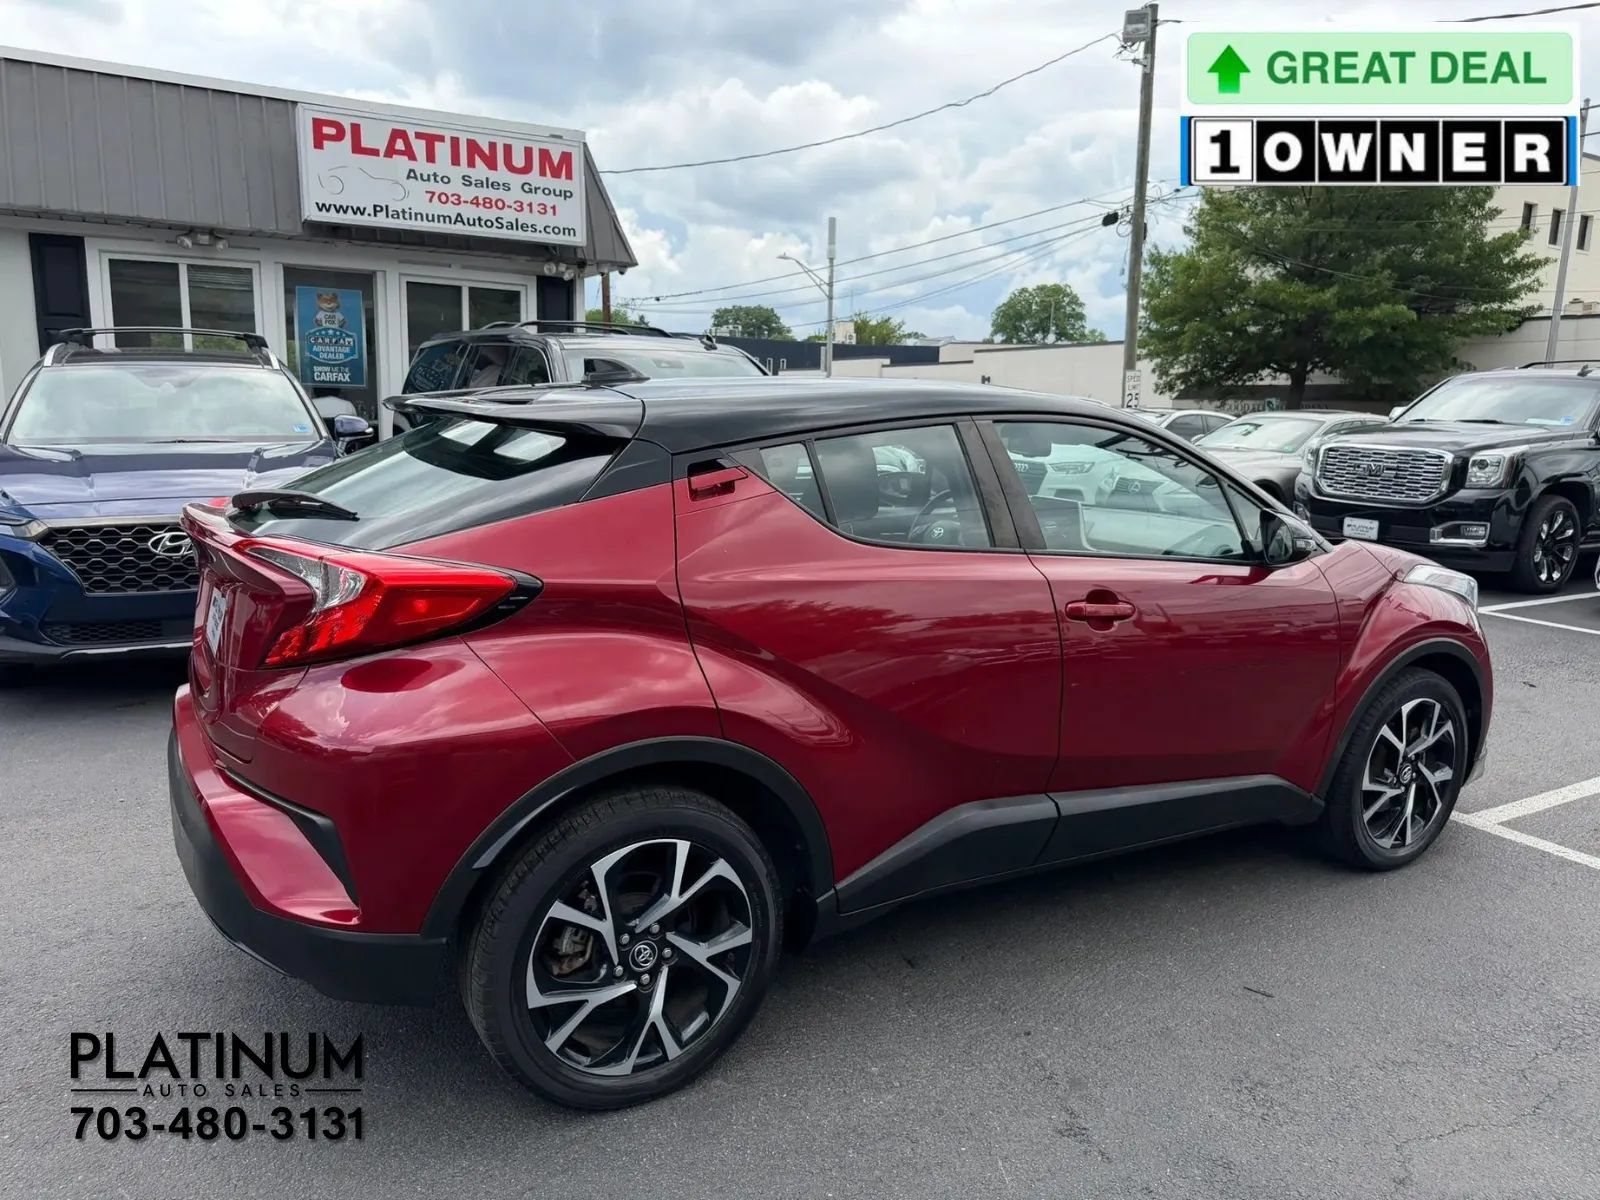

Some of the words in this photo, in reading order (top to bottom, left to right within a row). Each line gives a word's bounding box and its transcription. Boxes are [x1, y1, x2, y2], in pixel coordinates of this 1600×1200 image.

[311, 117, 574, 181] PLATINUM
[406, 168, 452, 185] Auto
[461, 176, 512, 192] Sales
[521, 182, 574, 201] Group
[425, 190, 559, 217] 703-480-3131
[315, 201, 577, 238] www.PlatinumAutoSales.com
[312, 345, 351, 353] ADVANTAGE
[314, 372, 351, 381] CARFAX
[1126, 393, 1140, 409] 25
